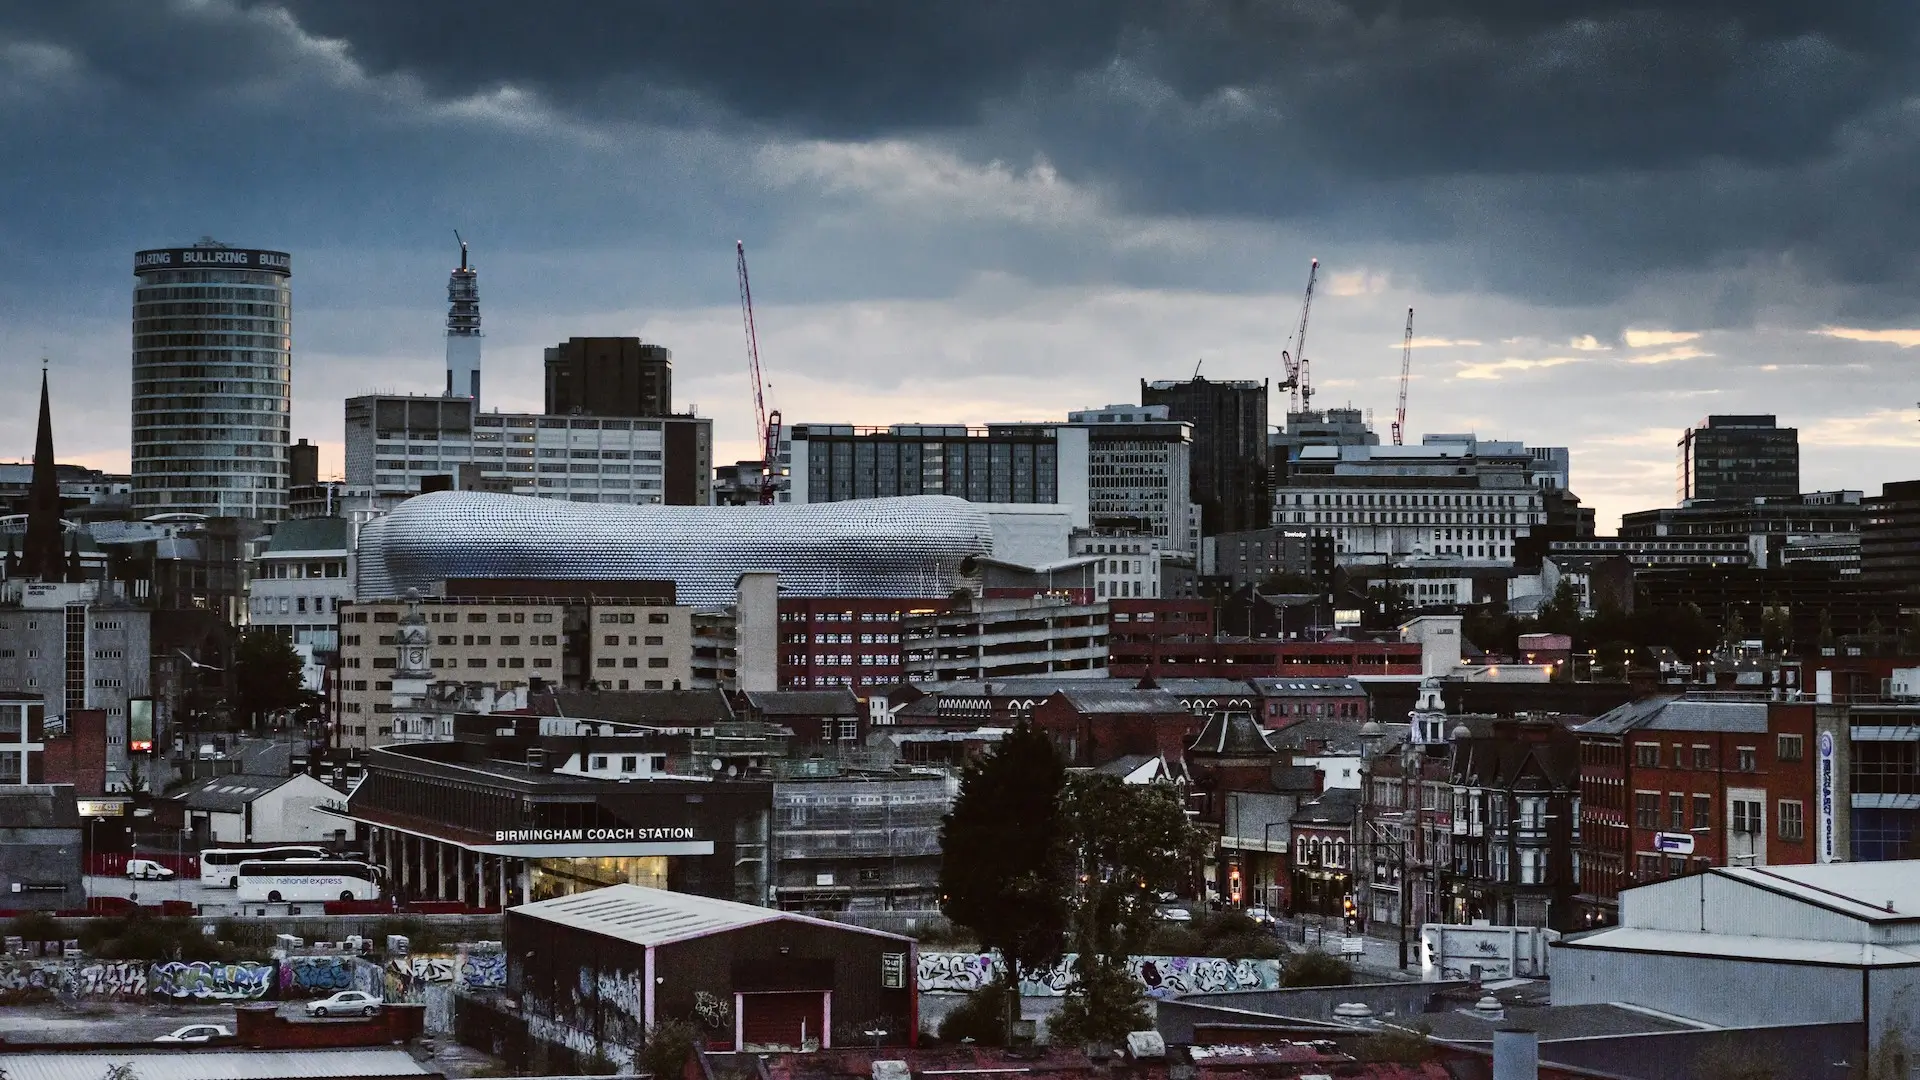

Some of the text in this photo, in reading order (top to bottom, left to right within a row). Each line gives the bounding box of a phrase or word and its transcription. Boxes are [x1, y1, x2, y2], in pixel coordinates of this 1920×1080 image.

[183, 251, 248, 264] BULLRING
[495, 827, 694, 842] BIRMINGHAM COACH STATION
[276, 877, 343, 886] national express
